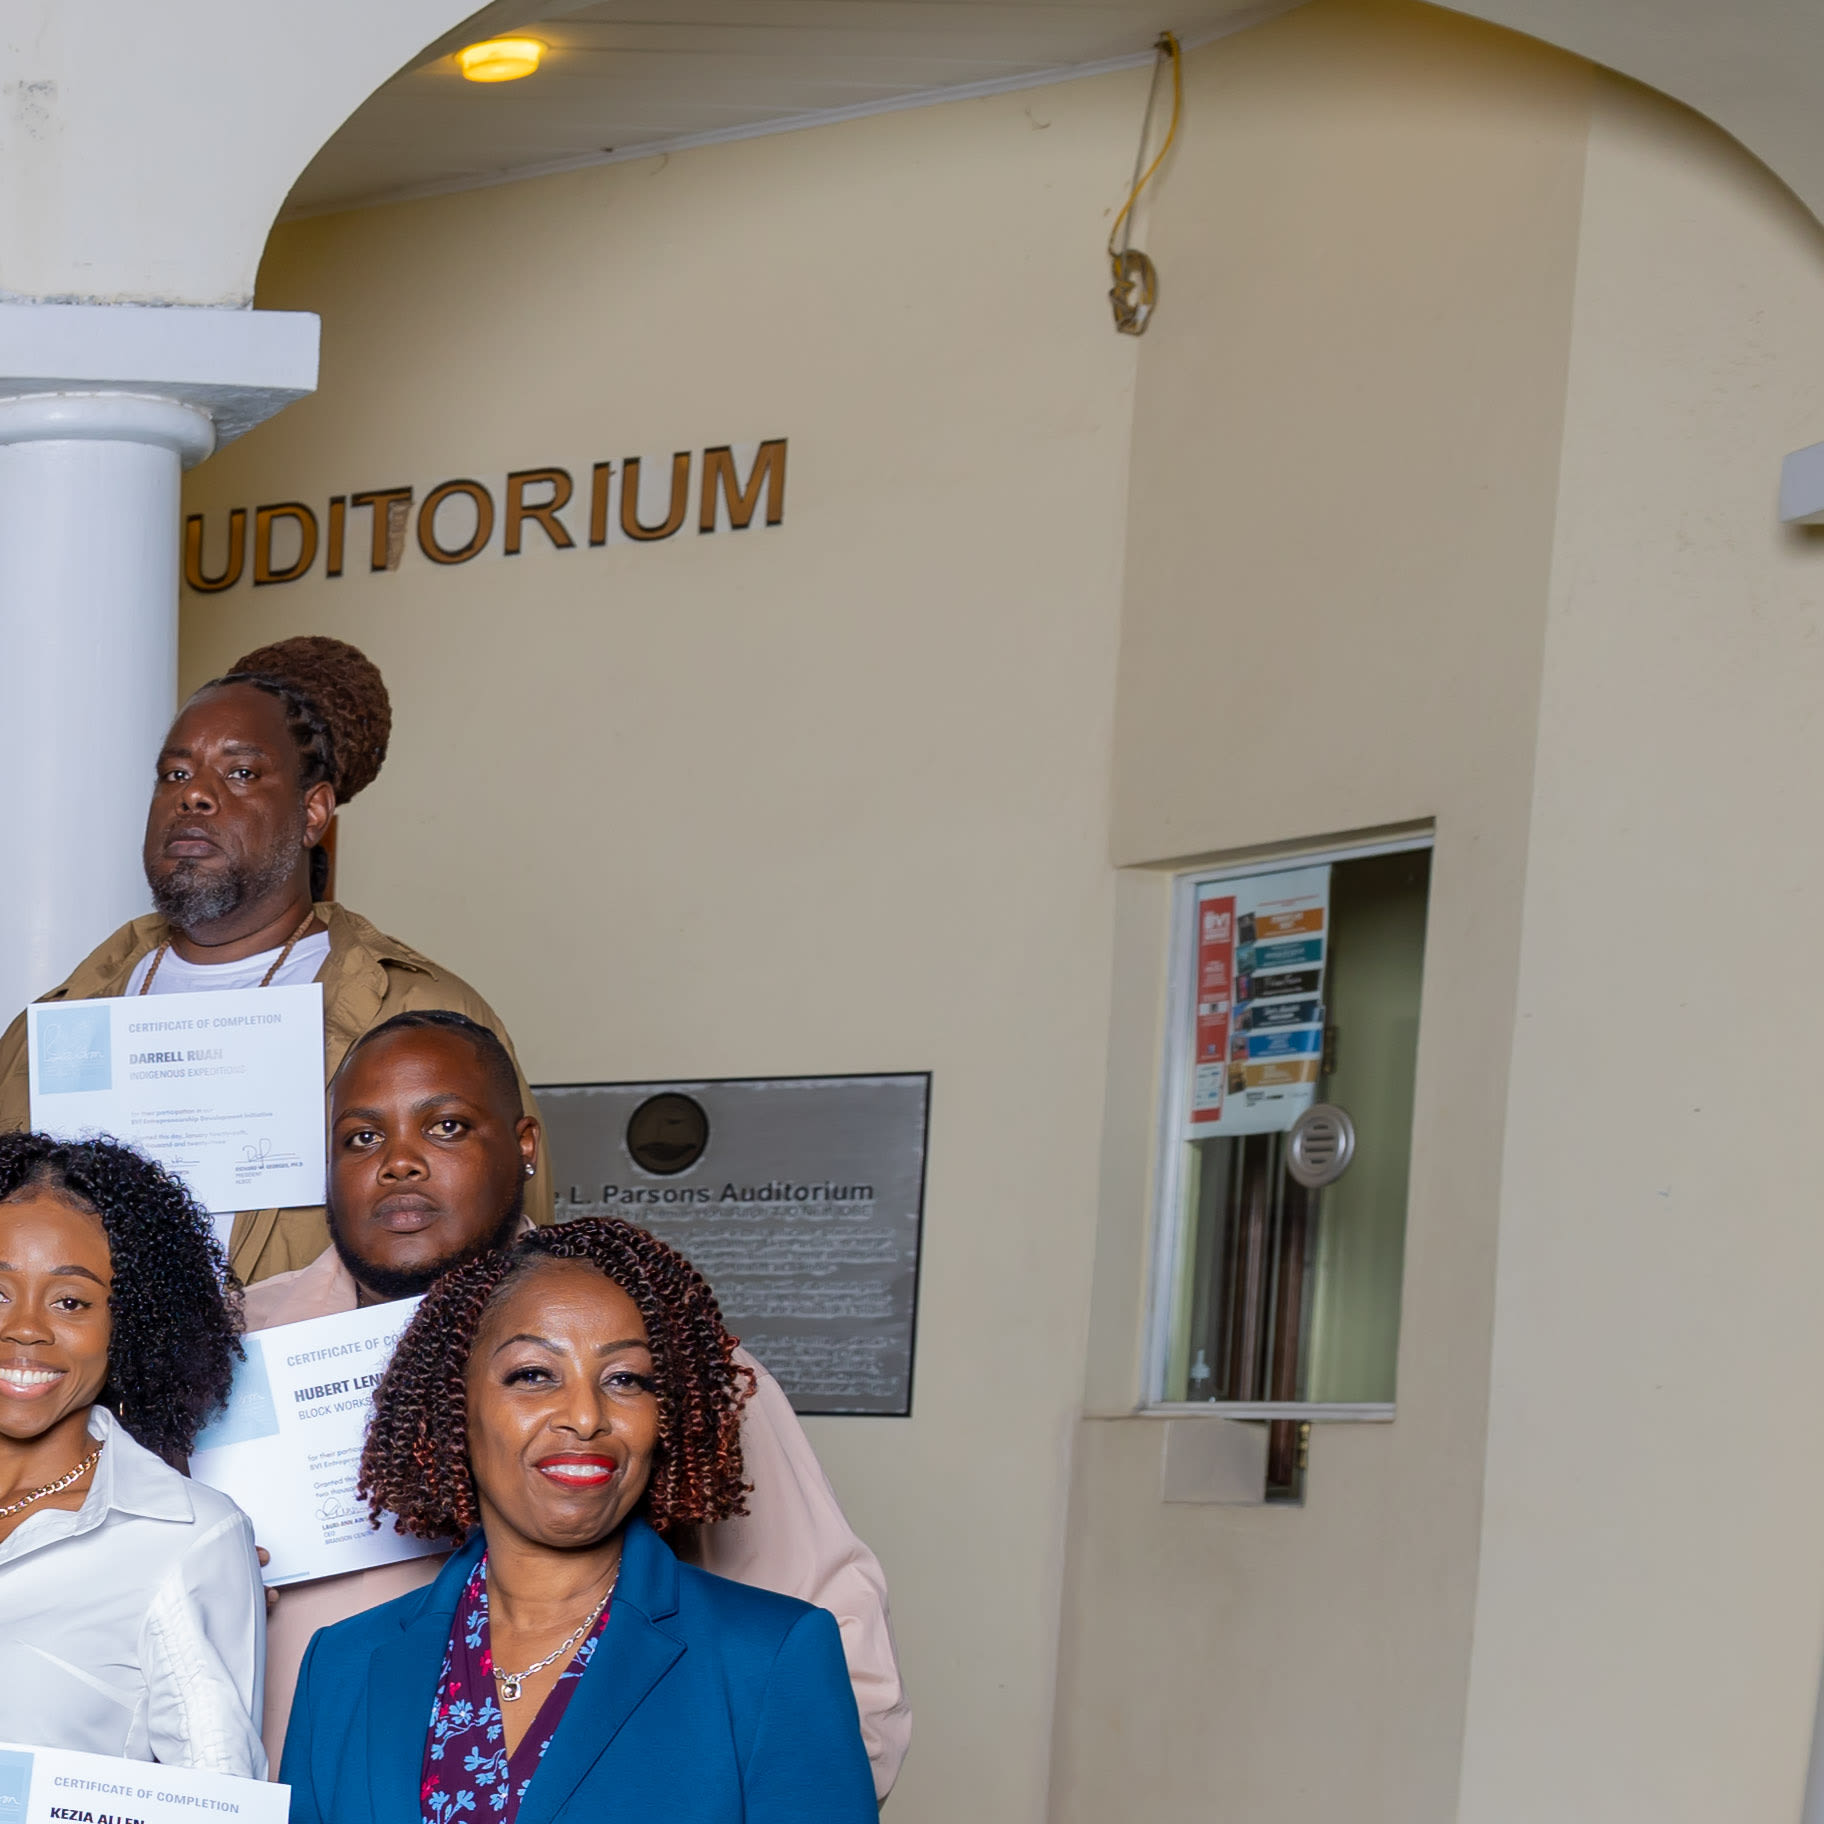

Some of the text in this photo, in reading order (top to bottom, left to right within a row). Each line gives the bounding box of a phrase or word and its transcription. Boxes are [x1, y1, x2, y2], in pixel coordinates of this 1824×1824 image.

[184, 437, 788, 594] UDITORIUM
[129, 1014, 281, 1033] CERTIFICATE OF COMPLETION
[129, 1051, 184, 1064] DARRELL
[130, 1068, 185, 1080] INDIGENOUS
[603, 1184, 710, 1204] Parsons
[719, 1181, 873, 1202] Auditorium
[287, 1342, 361, 1366] CERTIFICATE
[365, 1338, 379, 1351] OF
[294, 1380, 350, 1402] HUBERT
[298, 1404, 332, 1420] BLOCK
[54, 1776, 239, 1814] CERTIFICATE OF COMPLETION
[50, 1807, 94, 1824] KEZIA
